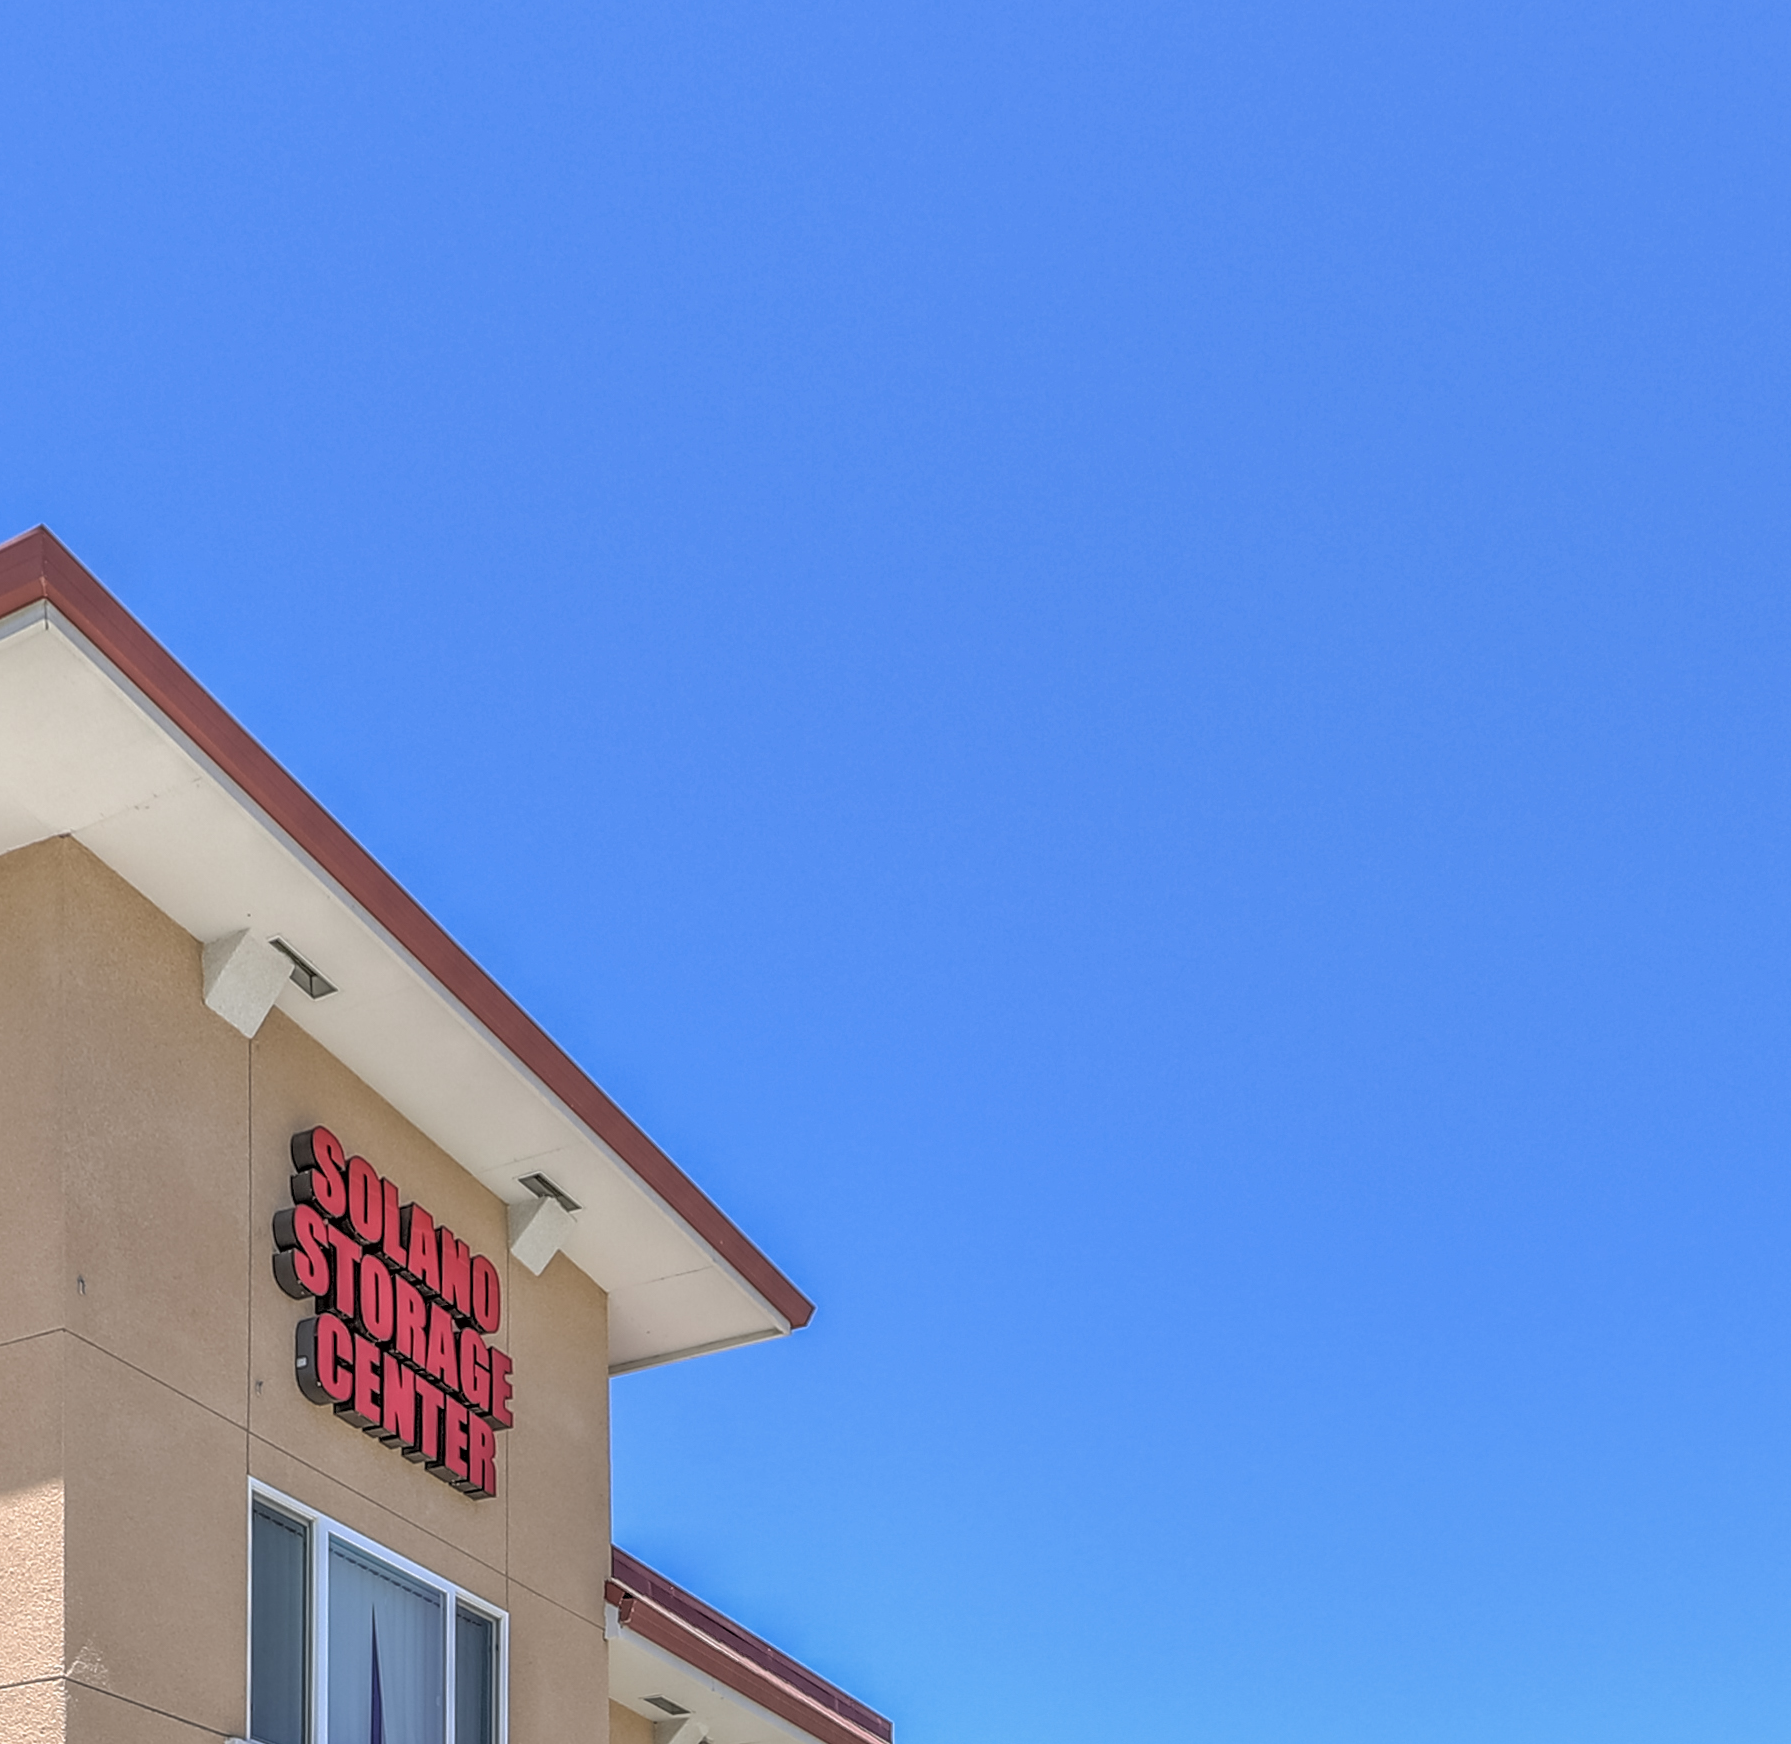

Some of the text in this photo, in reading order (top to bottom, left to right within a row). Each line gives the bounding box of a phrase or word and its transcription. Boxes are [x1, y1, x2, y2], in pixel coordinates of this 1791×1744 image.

[293, 1203, 513, 1429] STORAGE
[311, 1125, 501, 1335] SOLANO
[316, 1312, 496, 1498] CENTER
